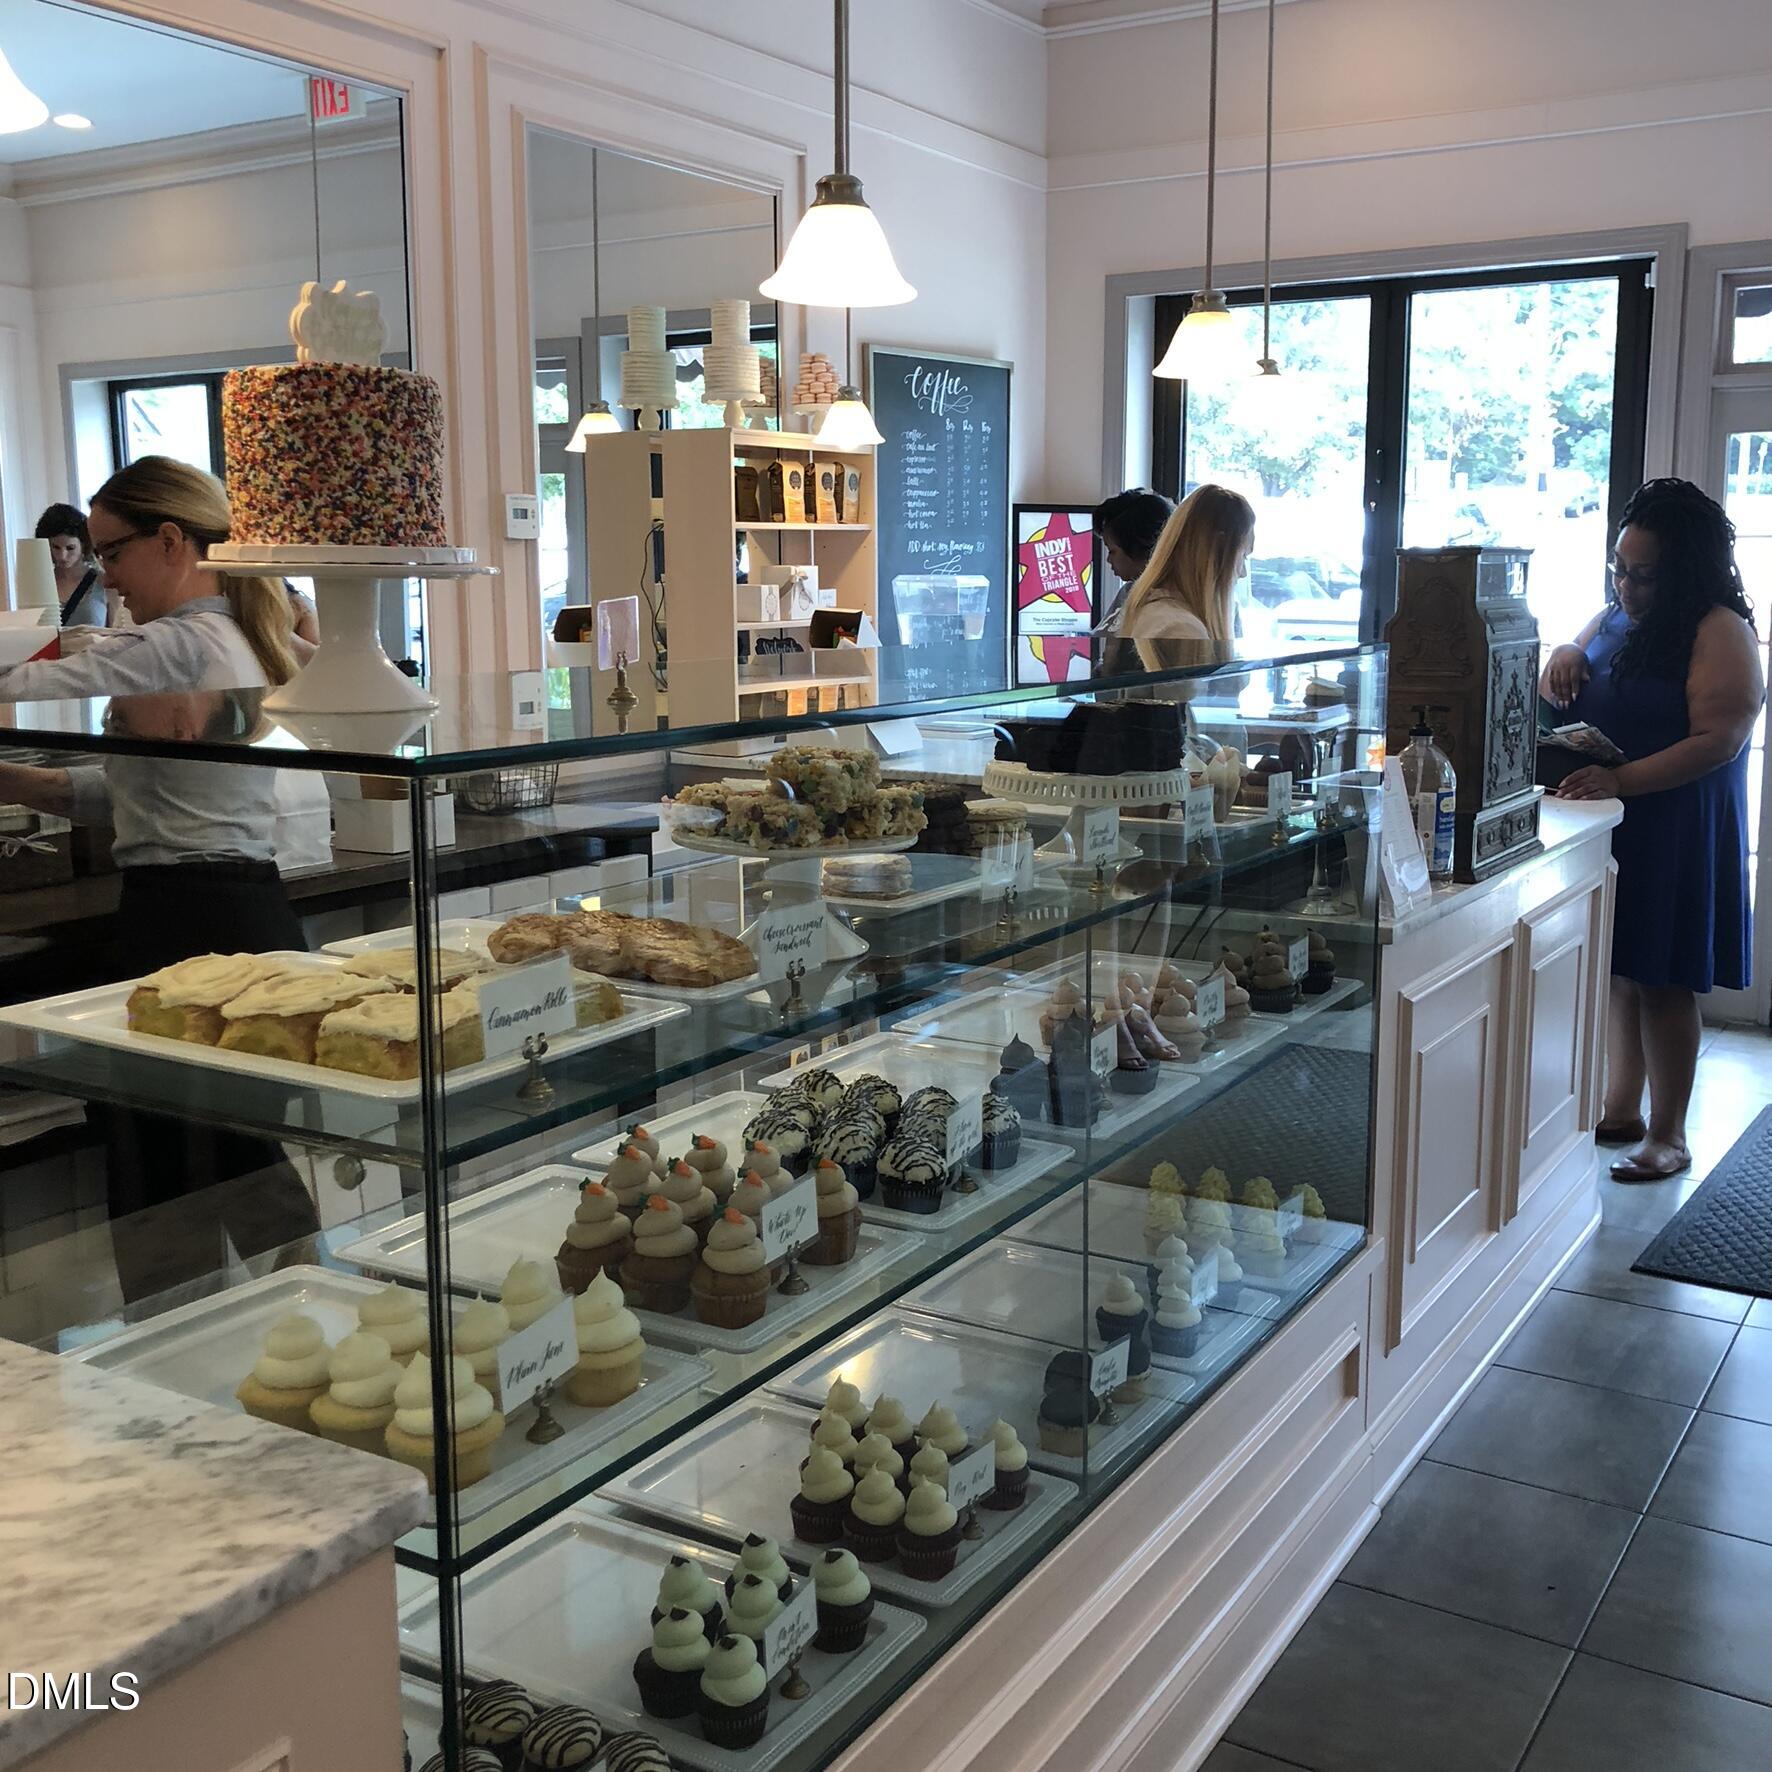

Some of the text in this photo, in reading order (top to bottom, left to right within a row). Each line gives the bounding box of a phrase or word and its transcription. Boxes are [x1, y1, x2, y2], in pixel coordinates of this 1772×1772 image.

[1038, 554, 1073, 577] BEST
[1042, 575, 1078, 592] TRIANGLE
[487, 1006, 541, 1030] Cinnamon
